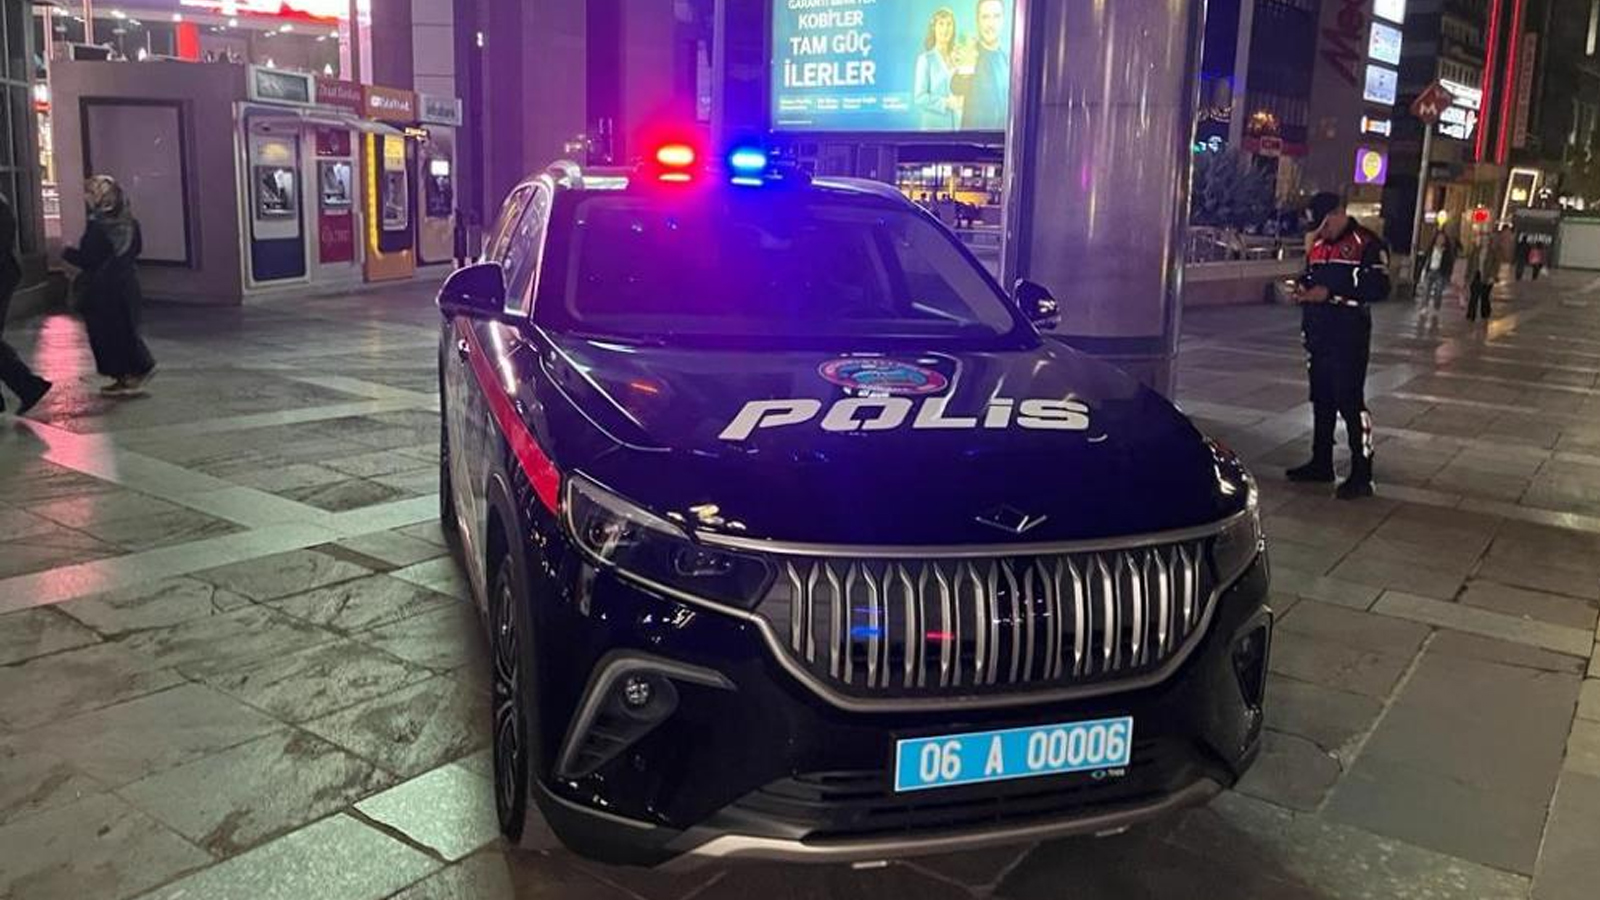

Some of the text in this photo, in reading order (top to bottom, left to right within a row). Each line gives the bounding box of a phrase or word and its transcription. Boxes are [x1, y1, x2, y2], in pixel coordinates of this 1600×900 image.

[798, 9, 864, 30] KOBİ'LER
[790, 29, 873, 57] TAM GÜÇ
[784, 58, 876, 88] İLERLER
[920, 722, 1126, 782] 06 A 00006
